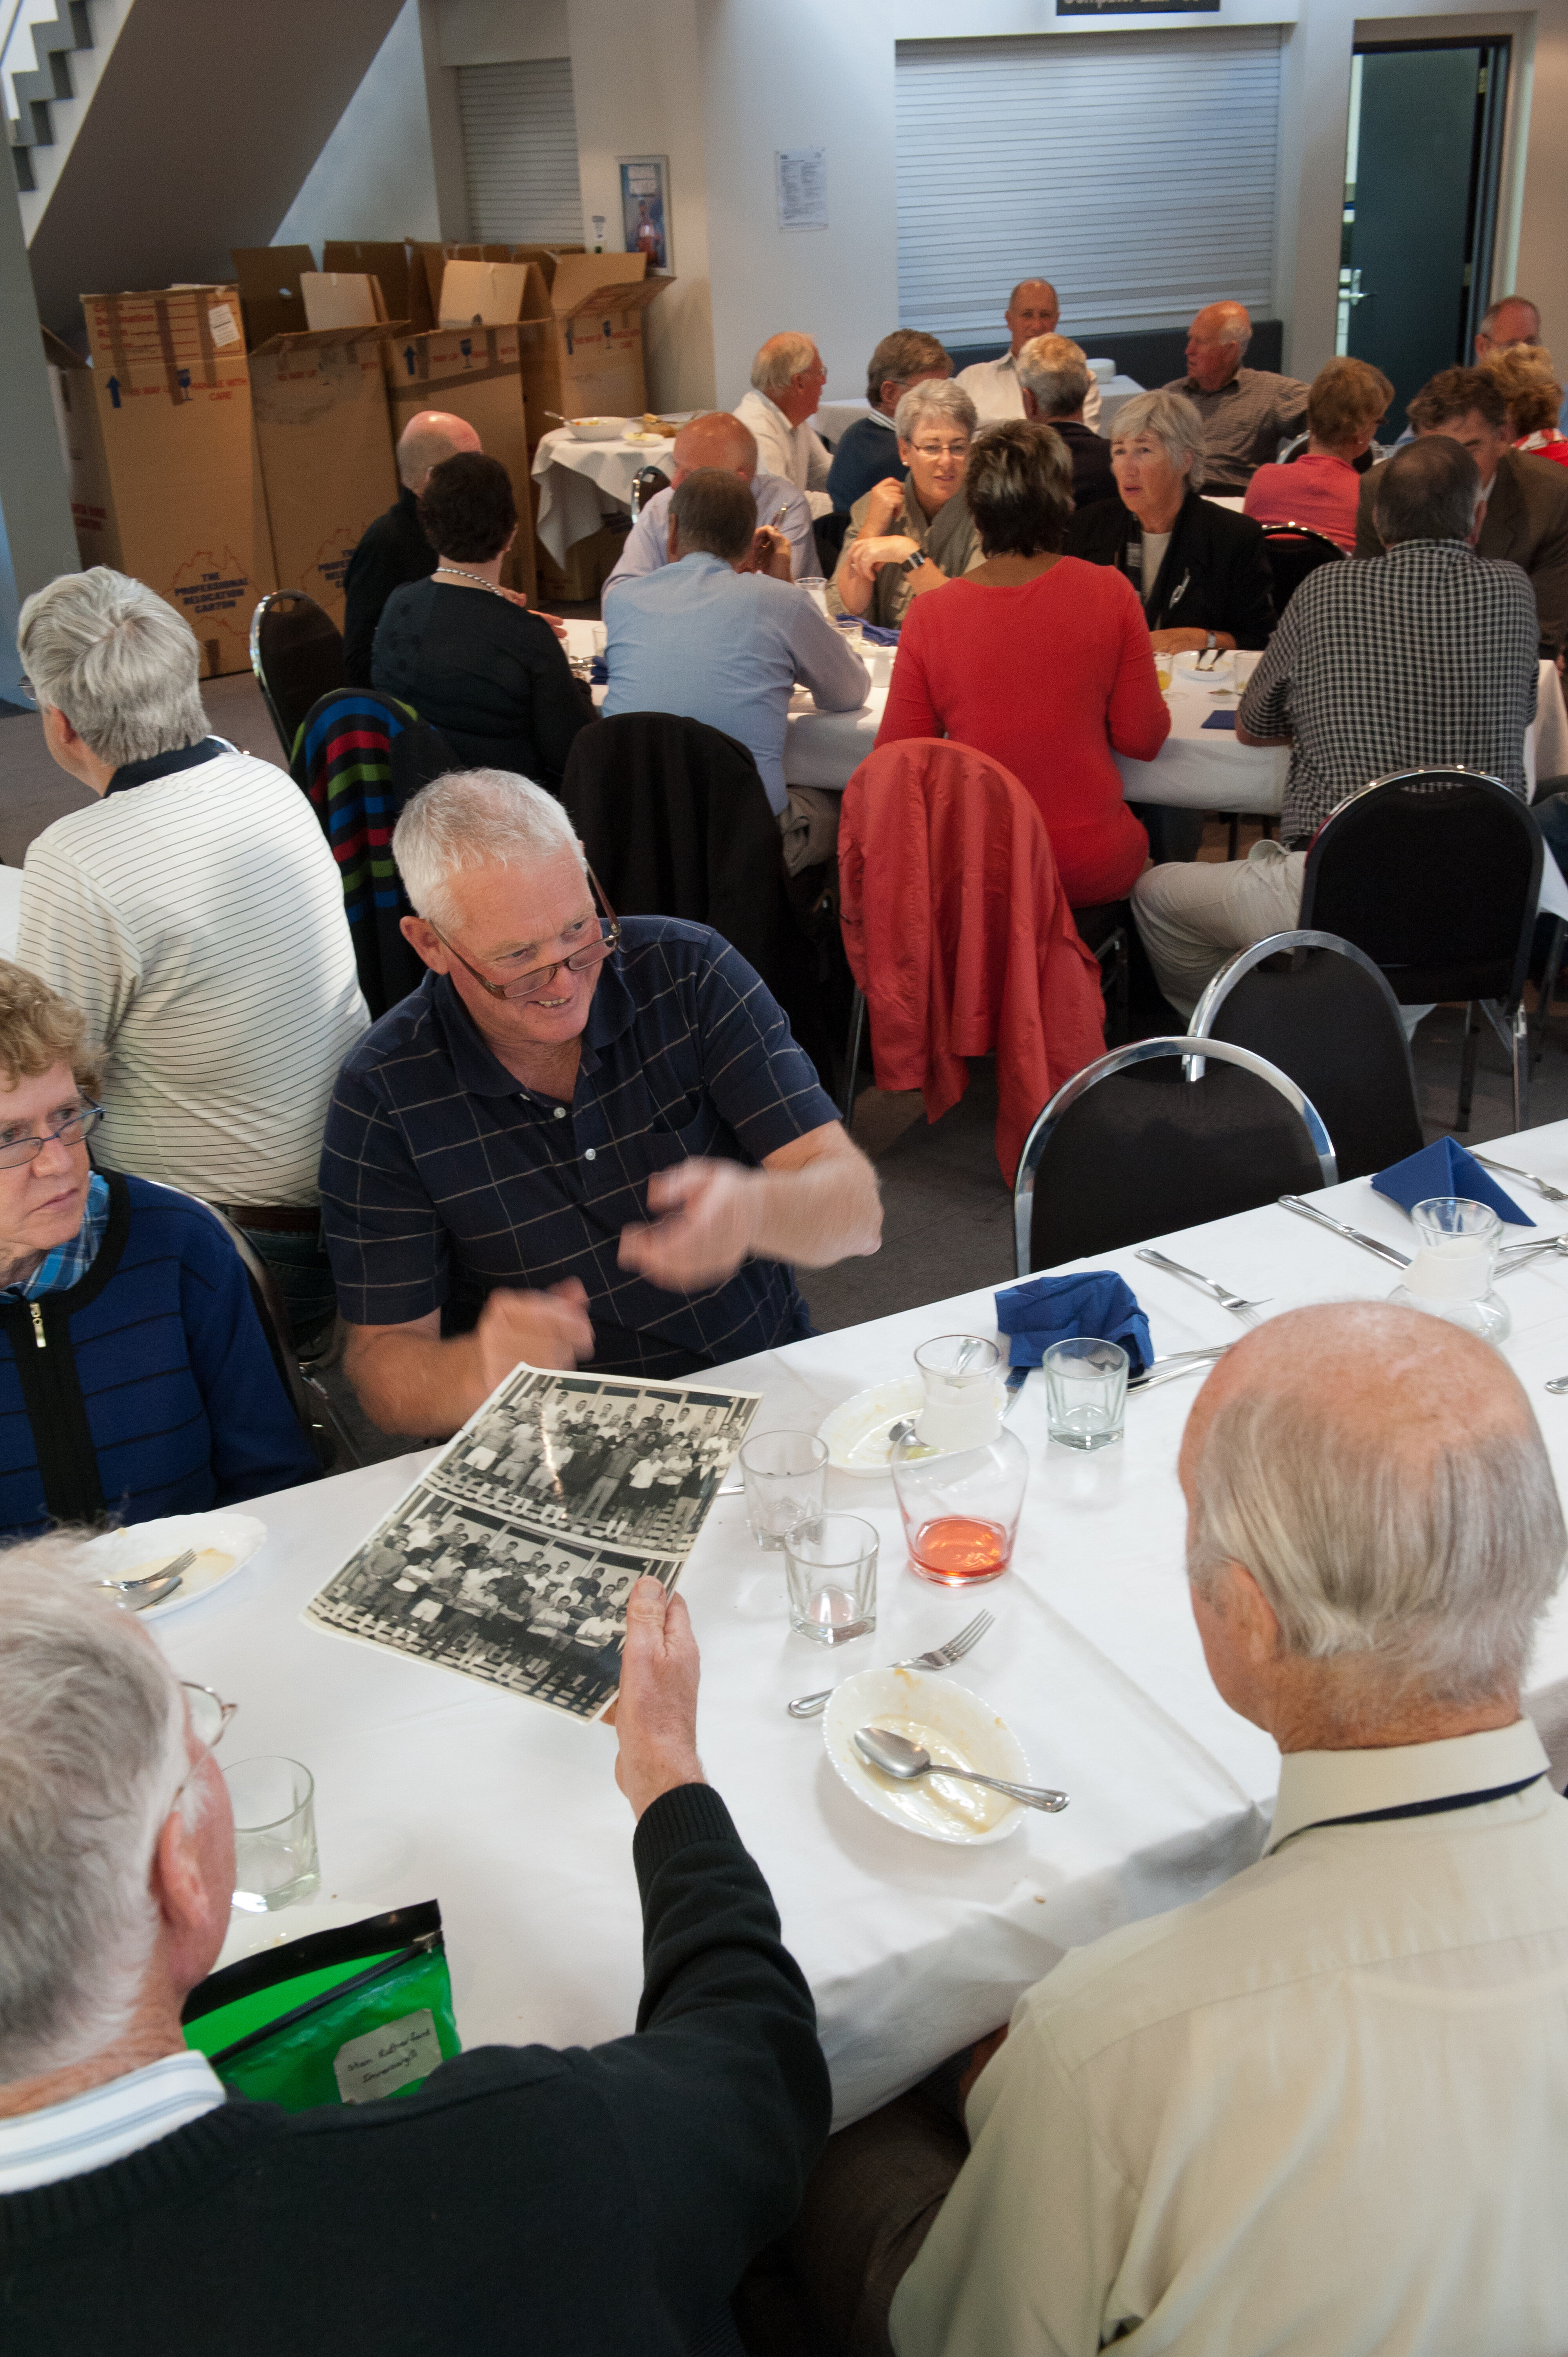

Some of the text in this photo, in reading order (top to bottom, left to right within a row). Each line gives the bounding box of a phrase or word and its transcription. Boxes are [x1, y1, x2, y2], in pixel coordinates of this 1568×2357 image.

[209, 391, 232, 401] CARE
[201, 572, 220, 582] THE
[174, 578, 250, 597] PROFESSIONAL
[183, 589, 245, 605] RELOCATION
[194, 600, 237, 614] CARTON
